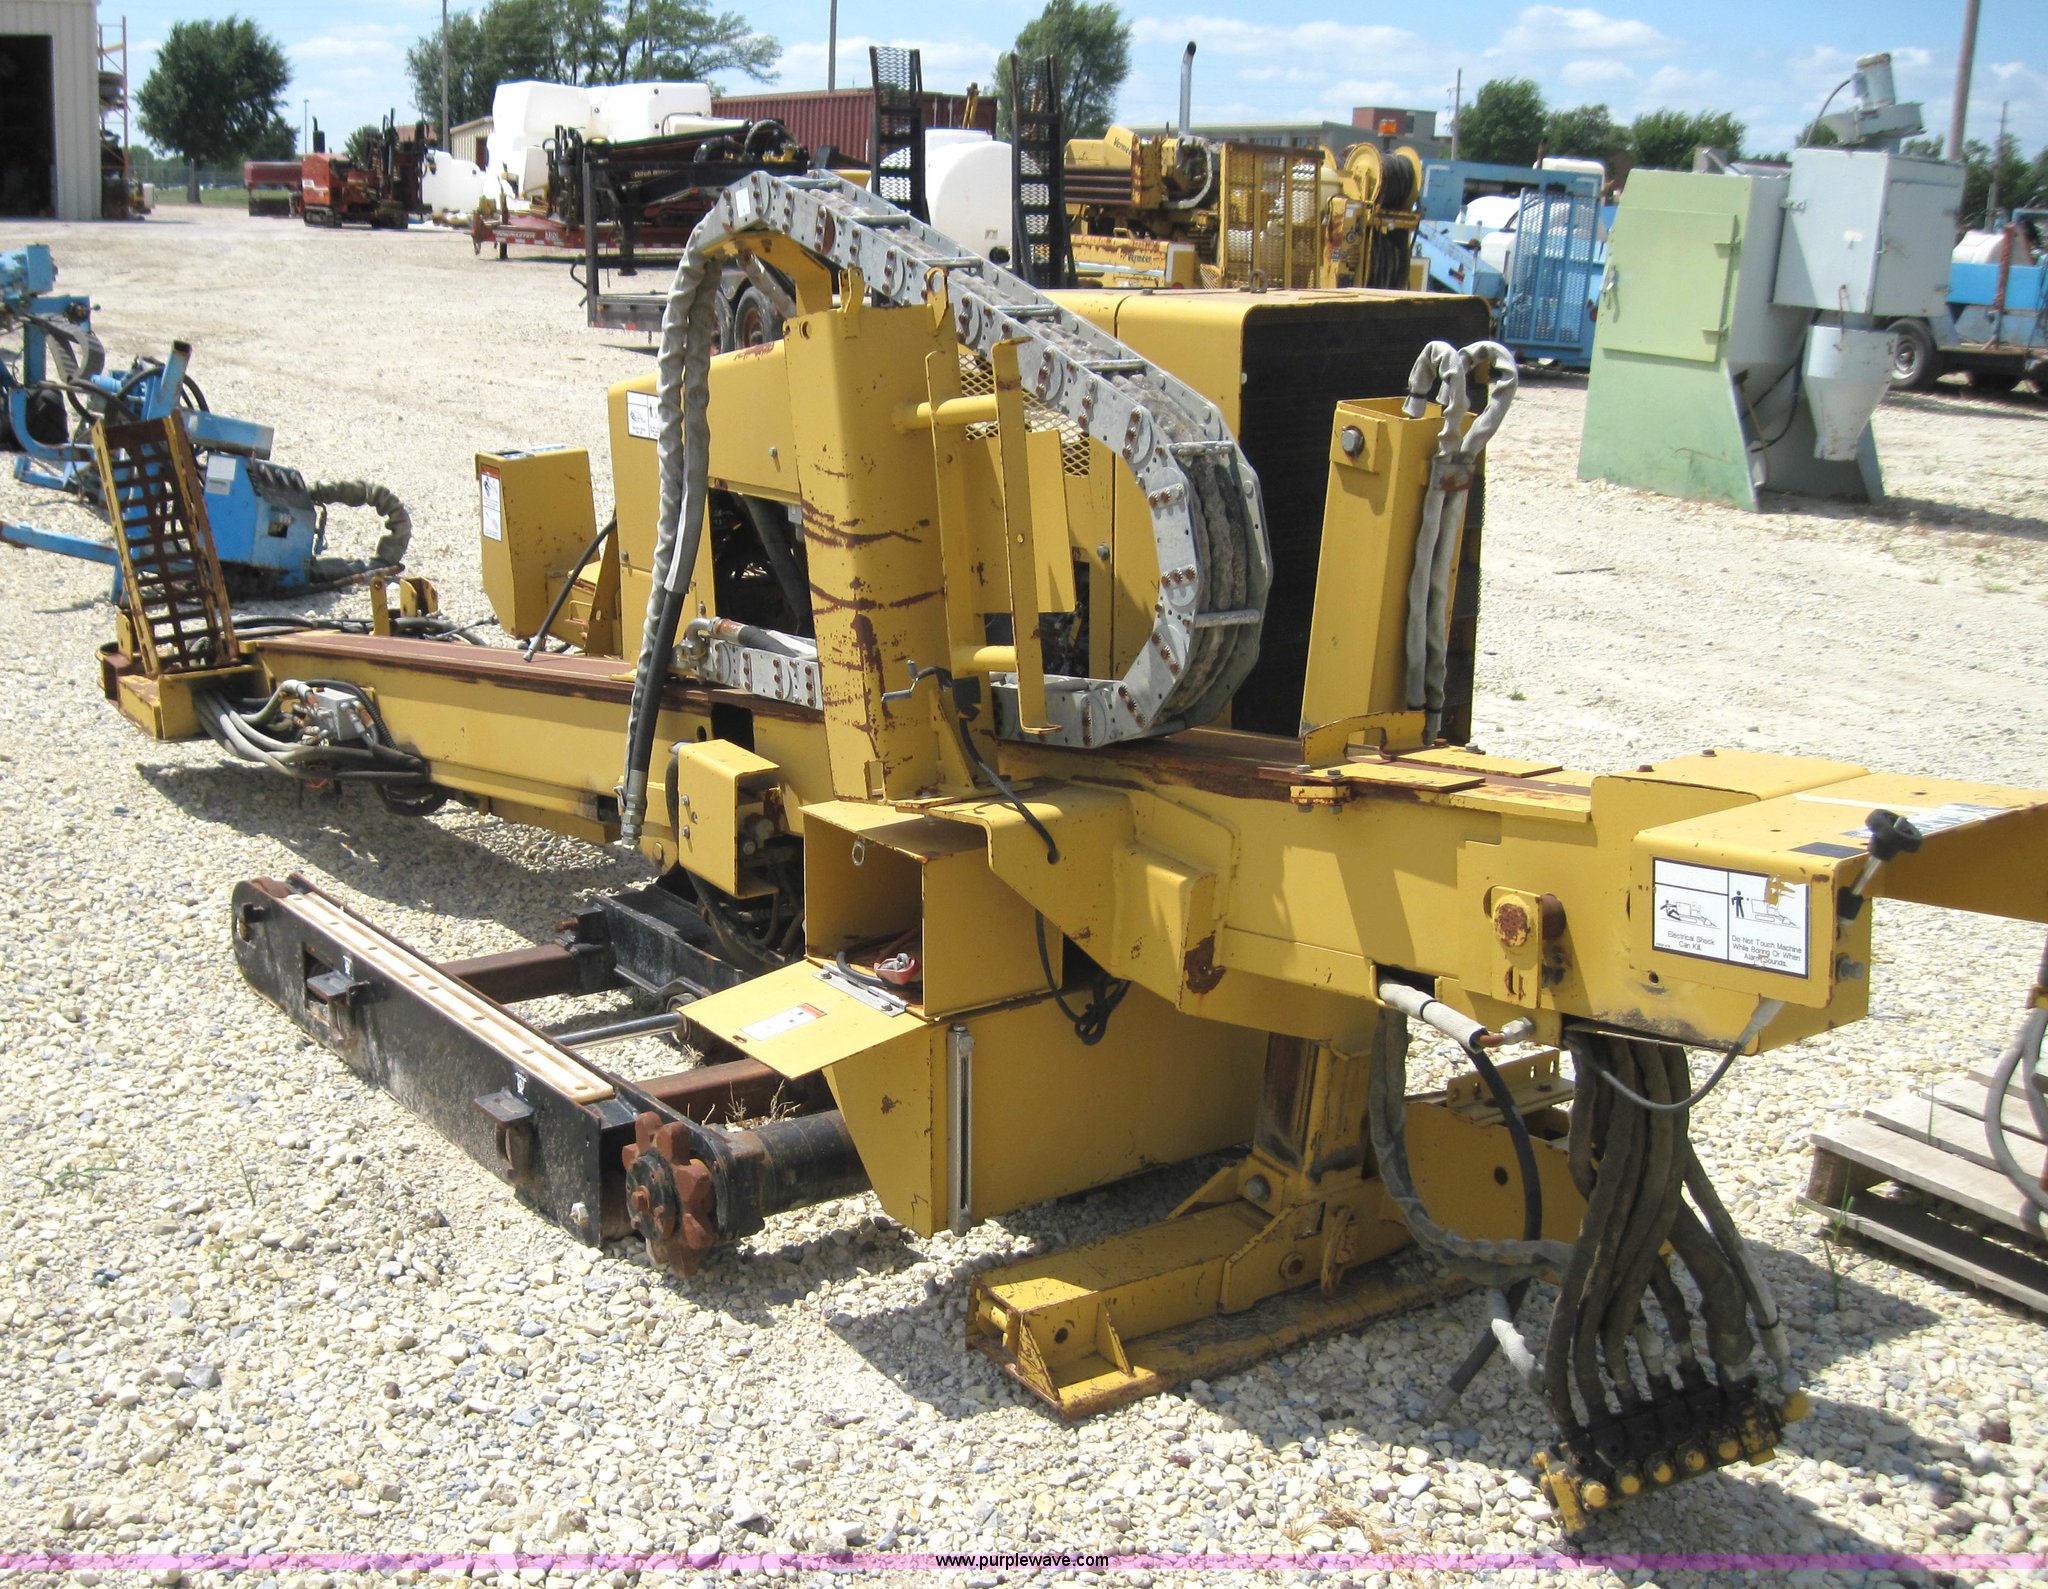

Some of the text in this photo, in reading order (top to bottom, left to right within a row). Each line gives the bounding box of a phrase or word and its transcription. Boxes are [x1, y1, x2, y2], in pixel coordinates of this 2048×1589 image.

[1113, 136, 1131, 155] Vermee
[1668, 930, 1715, 945] Electrical Shock
[1679, 941, 1691, 949] Can
[1743, 937, 1753, 945] Not
[1756, 939, 1775, 949] Touch
[1777, 942, 1802, 954] Machine
[1733, 943, 1749, 951] While
[1751, 946, 1770, 957] Boring
[1783, 952, 1801, 961] When
